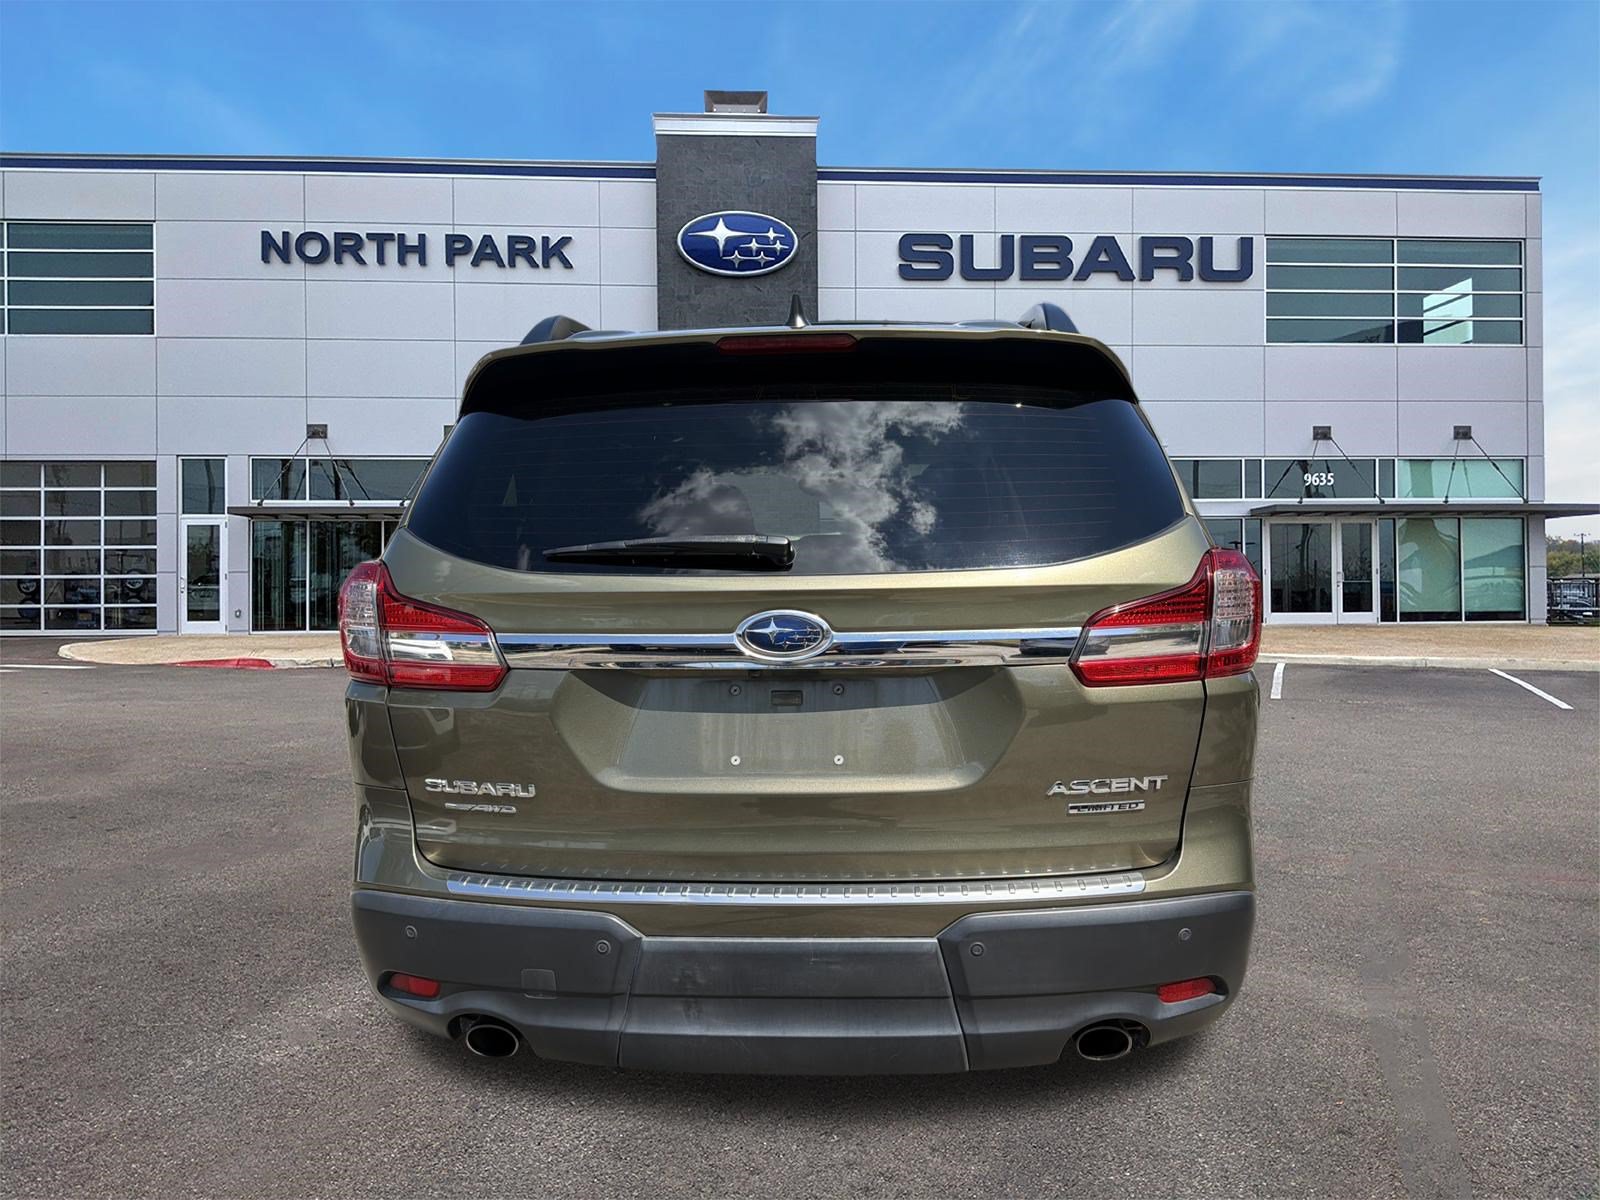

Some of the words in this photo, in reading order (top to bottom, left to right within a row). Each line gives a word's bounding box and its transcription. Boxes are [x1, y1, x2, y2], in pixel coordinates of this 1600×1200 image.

[261, 231, 427, 266] NORTH
[445, 234, 574, 269] PARK
[898, 233, 1254, 282] SUBARU
[1304, 472, 1334, 486] 9635
[424, 778, 536, 797] SUBARU
[1046, 775, 1168, 795] ASCENT
[1076, 801, 1140, 812] LIMITED
